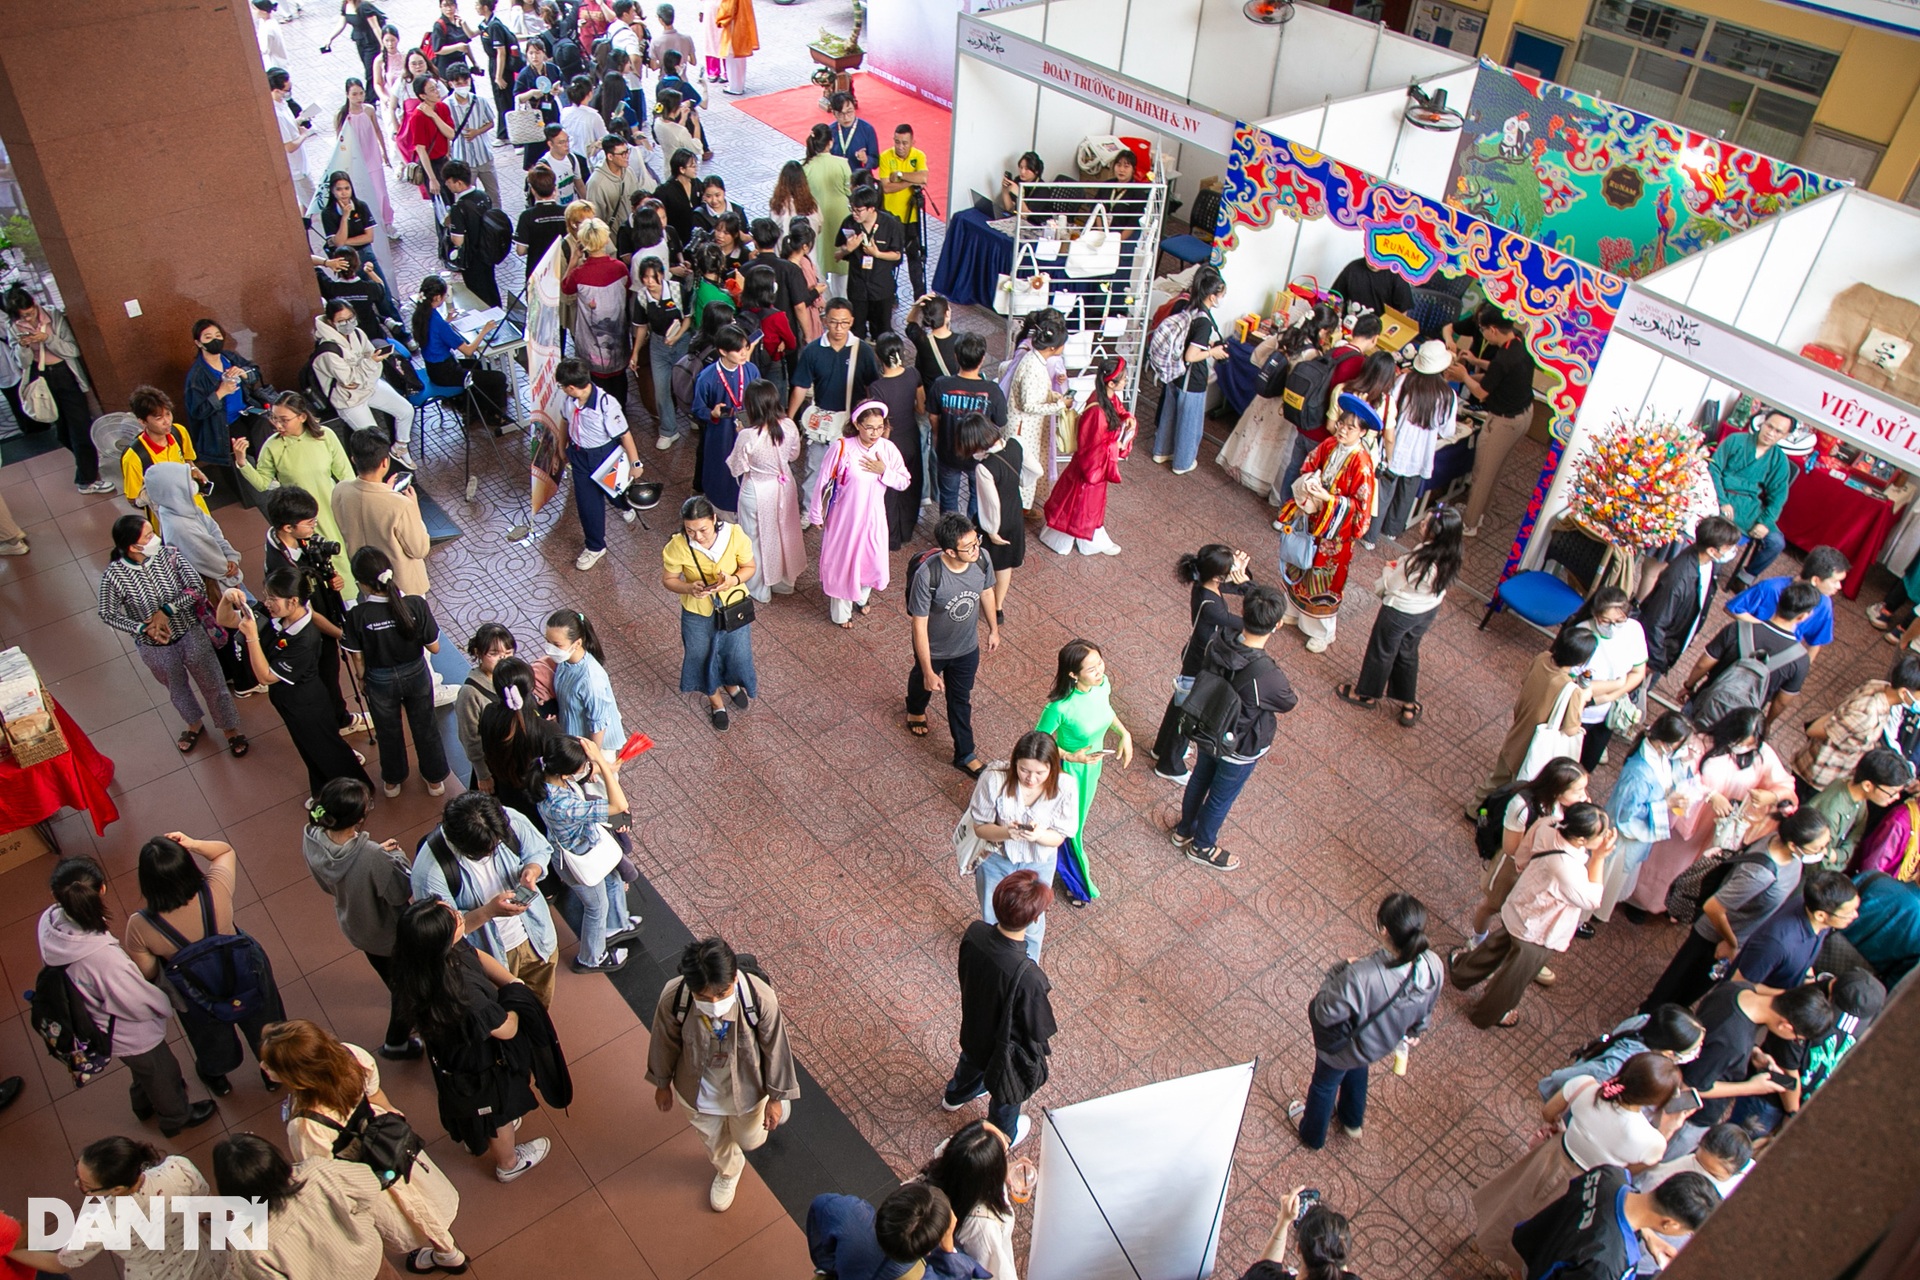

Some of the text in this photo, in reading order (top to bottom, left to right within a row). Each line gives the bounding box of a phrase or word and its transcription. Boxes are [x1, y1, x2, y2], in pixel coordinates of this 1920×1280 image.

[1042, 60, 1201, 134] ĐOÀN TRƯỜNG ĐH KHXH & NV
[1819, 390, 1874, 429] VIỆT
[1871, 415, 1911, 443] SỬ
[944, 595, 959, 610] NEW
[959, 590, 980, 601] JERSEY
